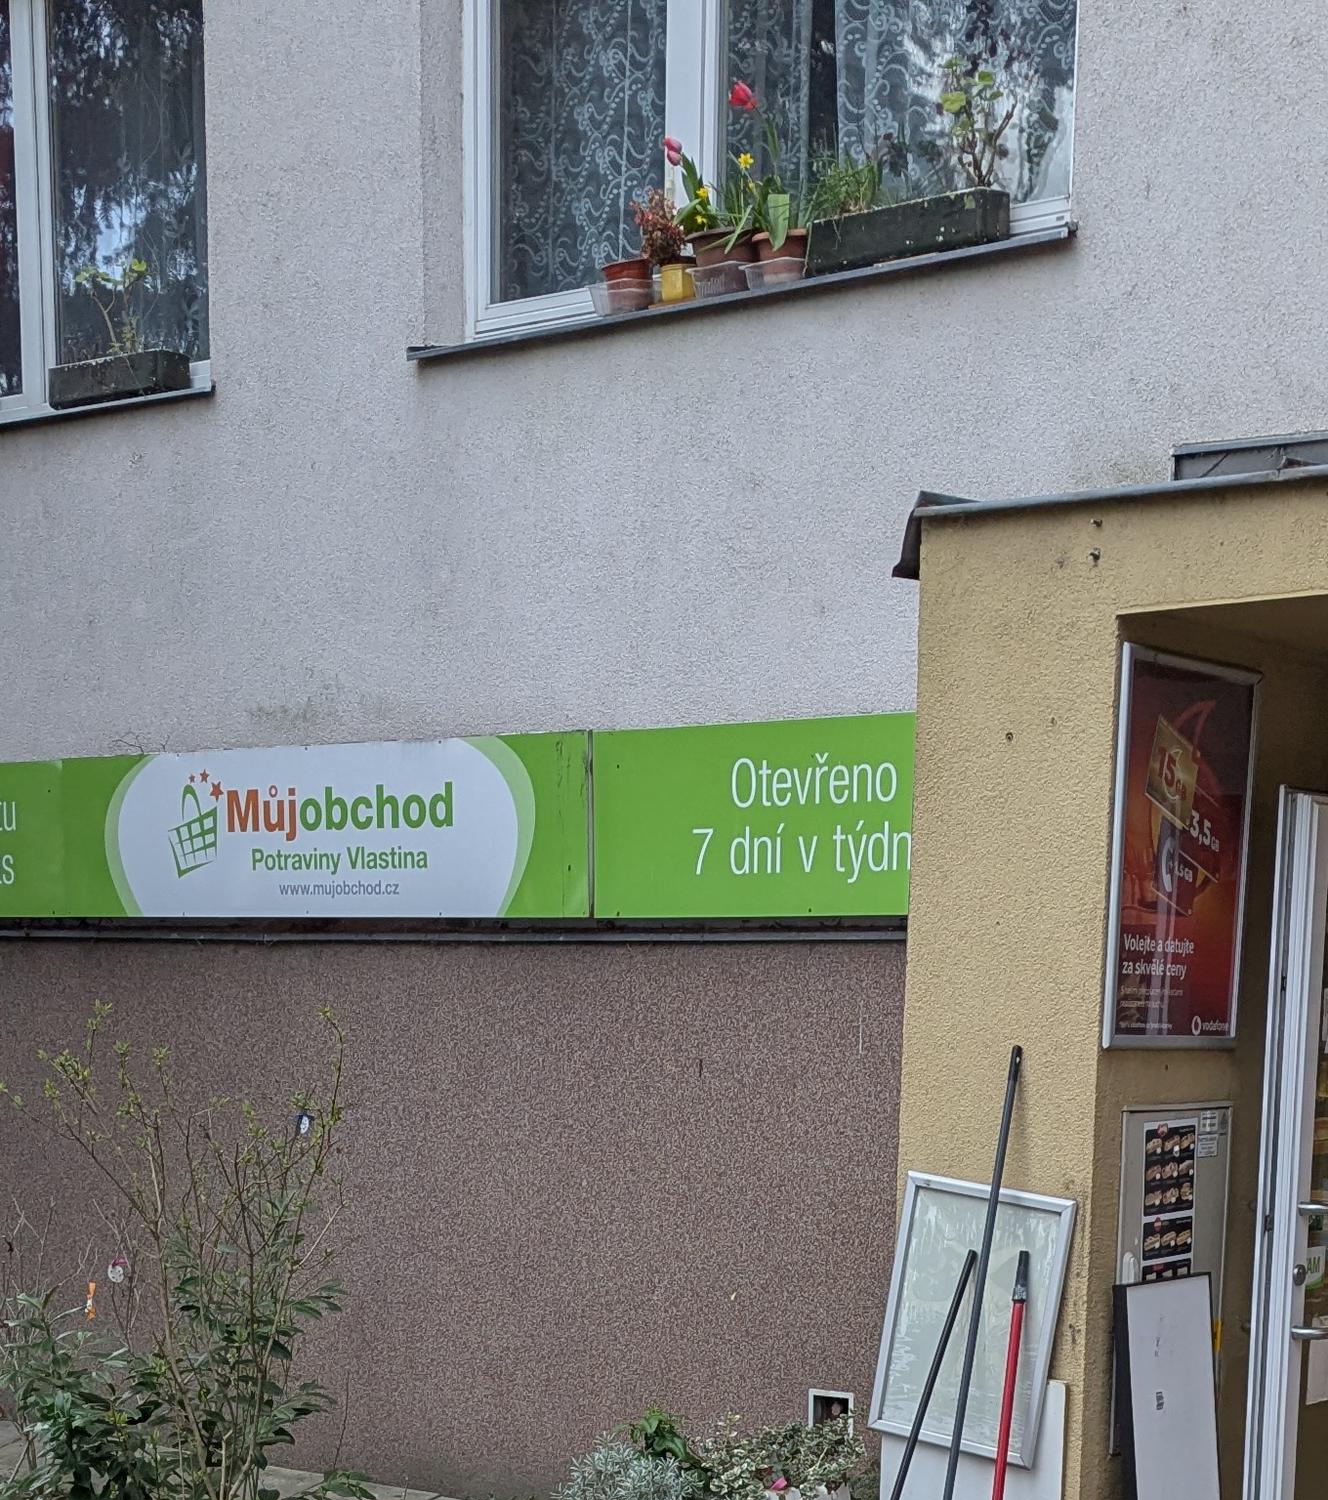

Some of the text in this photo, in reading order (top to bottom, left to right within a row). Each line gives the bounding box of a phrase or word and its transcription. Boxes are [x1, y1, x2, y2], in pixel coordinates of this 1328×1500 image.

[730, 752, 898, 808] Otevřeno
[226, 781, 454, 842] Můjobchod
[251, 846, 428, 875] Potraviny Vlastina
[692, 820, 912, 883] 7 dní v týdn
[279, 880, 400, 898] www.mujobchod.cz
[1124, 934, 1194, 957] Volejte a datujte
[1122, 959, 1187, 980] za skvělé ceny
